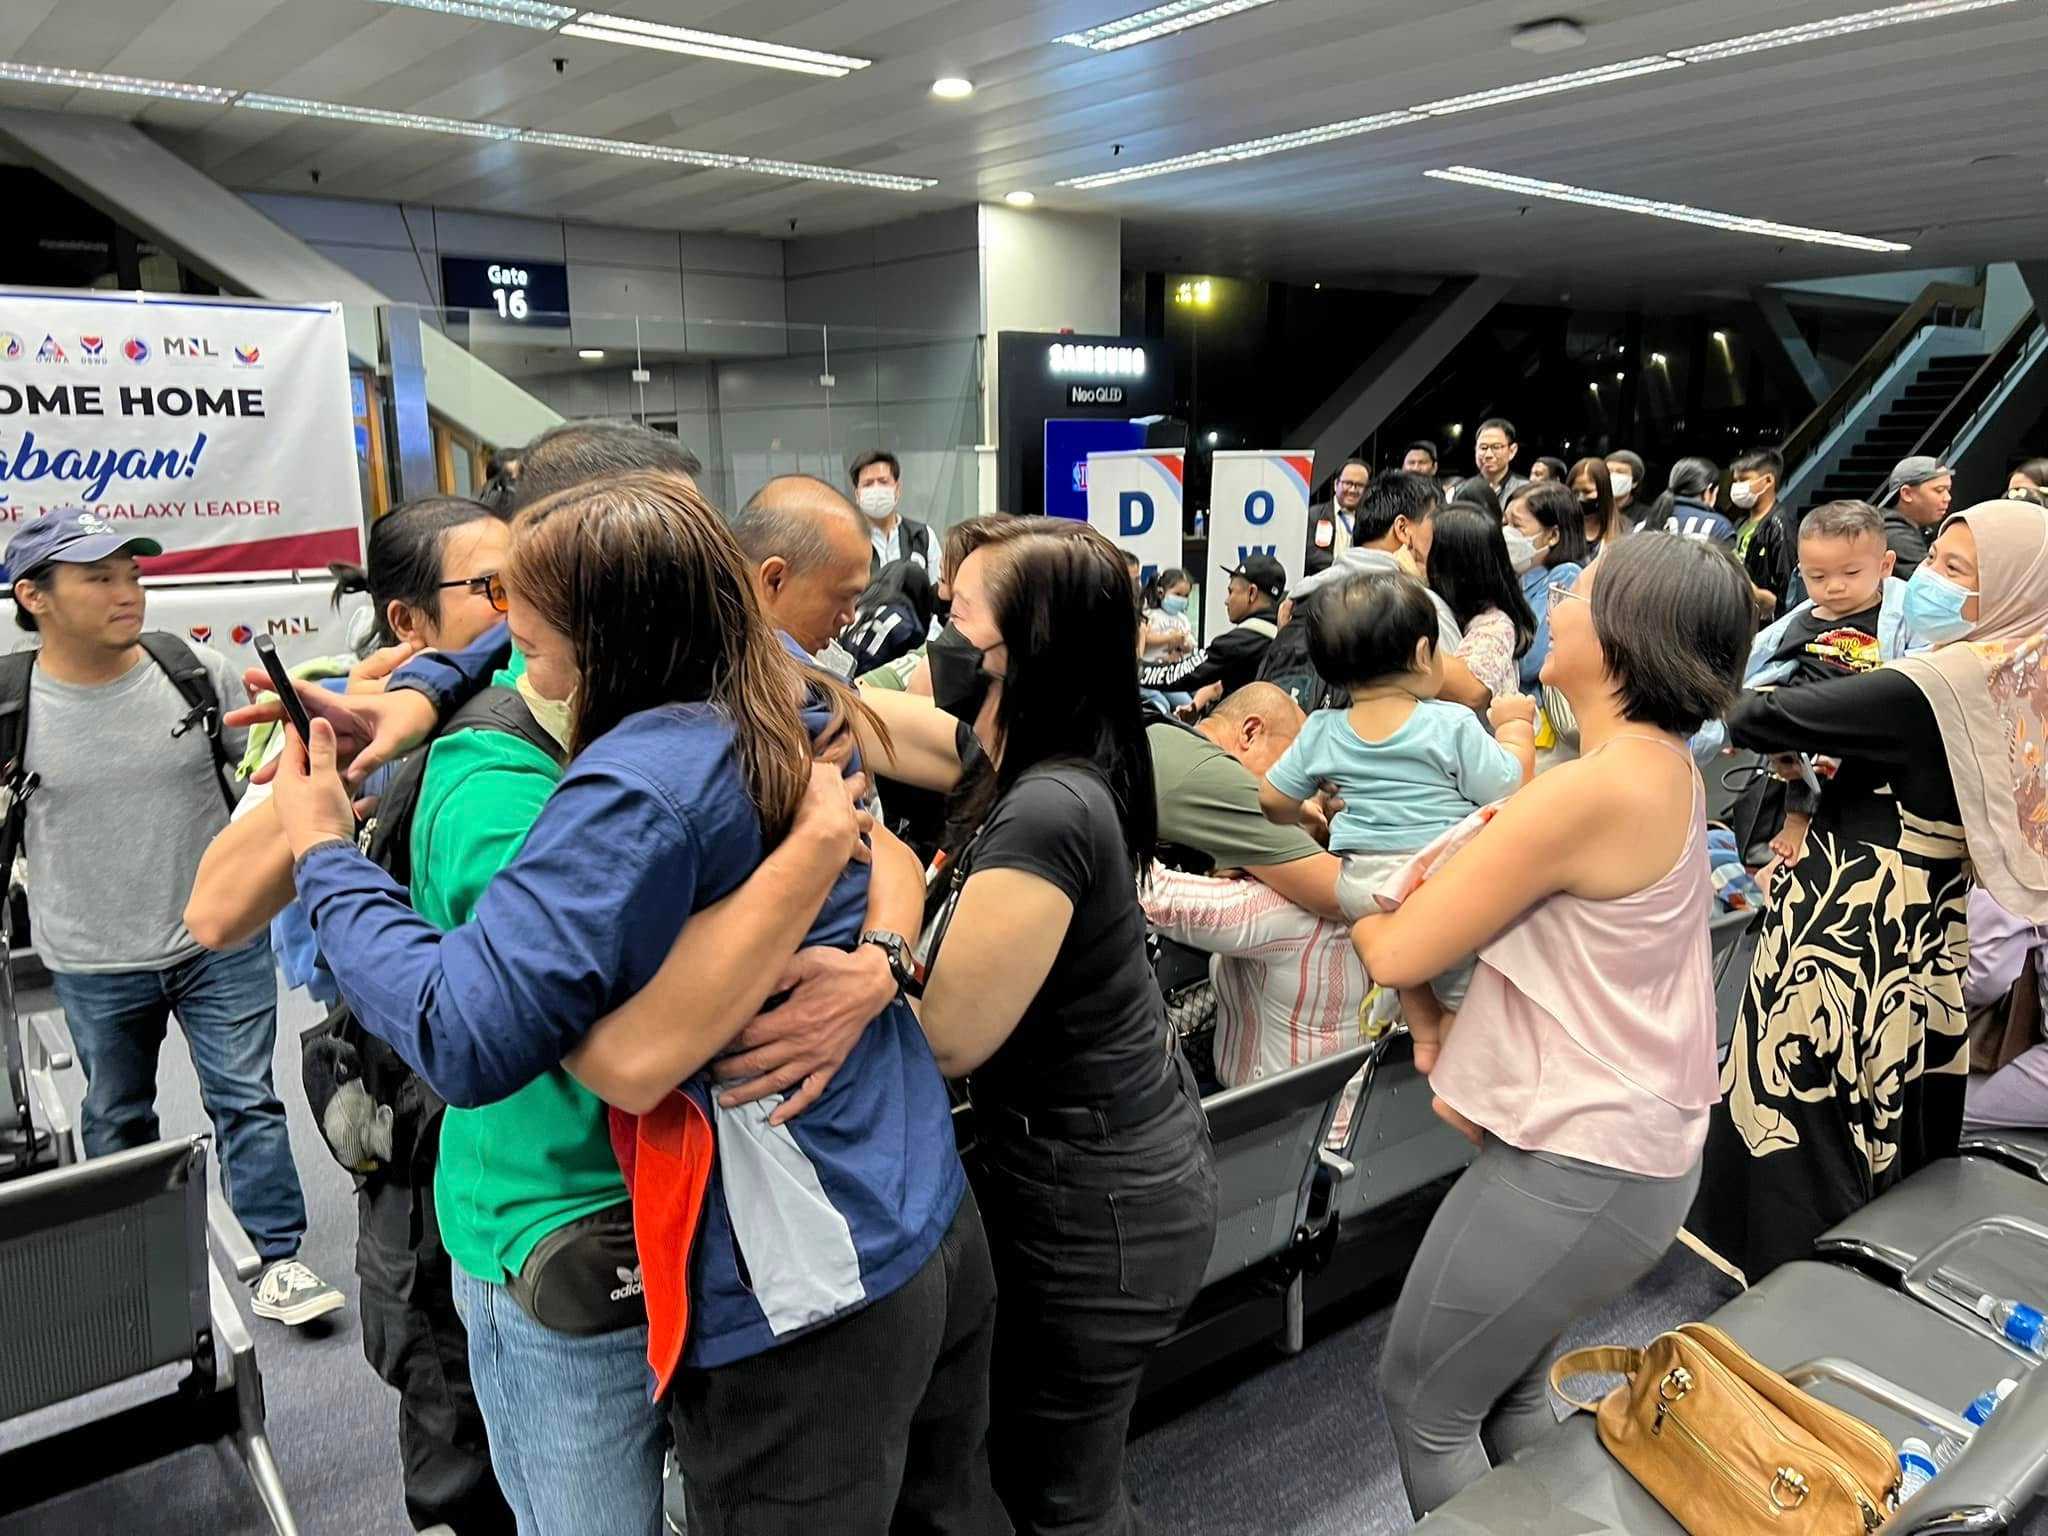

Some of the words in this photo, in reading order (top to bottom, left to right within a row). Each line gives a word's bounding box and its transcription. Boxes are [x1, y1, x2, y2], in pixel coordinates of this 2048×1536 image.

[487, 264, 528, 286] Gate
[492, 288, 528, 320] 16
[1048, 343, 1146, 375] SAMSUNG
[119, 386, 266, 417] HOME
[1071, 386, 1095, 403] Neo
[1095, 386, 1122, 403] QLED
[95, 502, 187, 520] GALAXY
[194, 500, 281, 517] LEADER
[610, 1281, 643, 1301] adid
